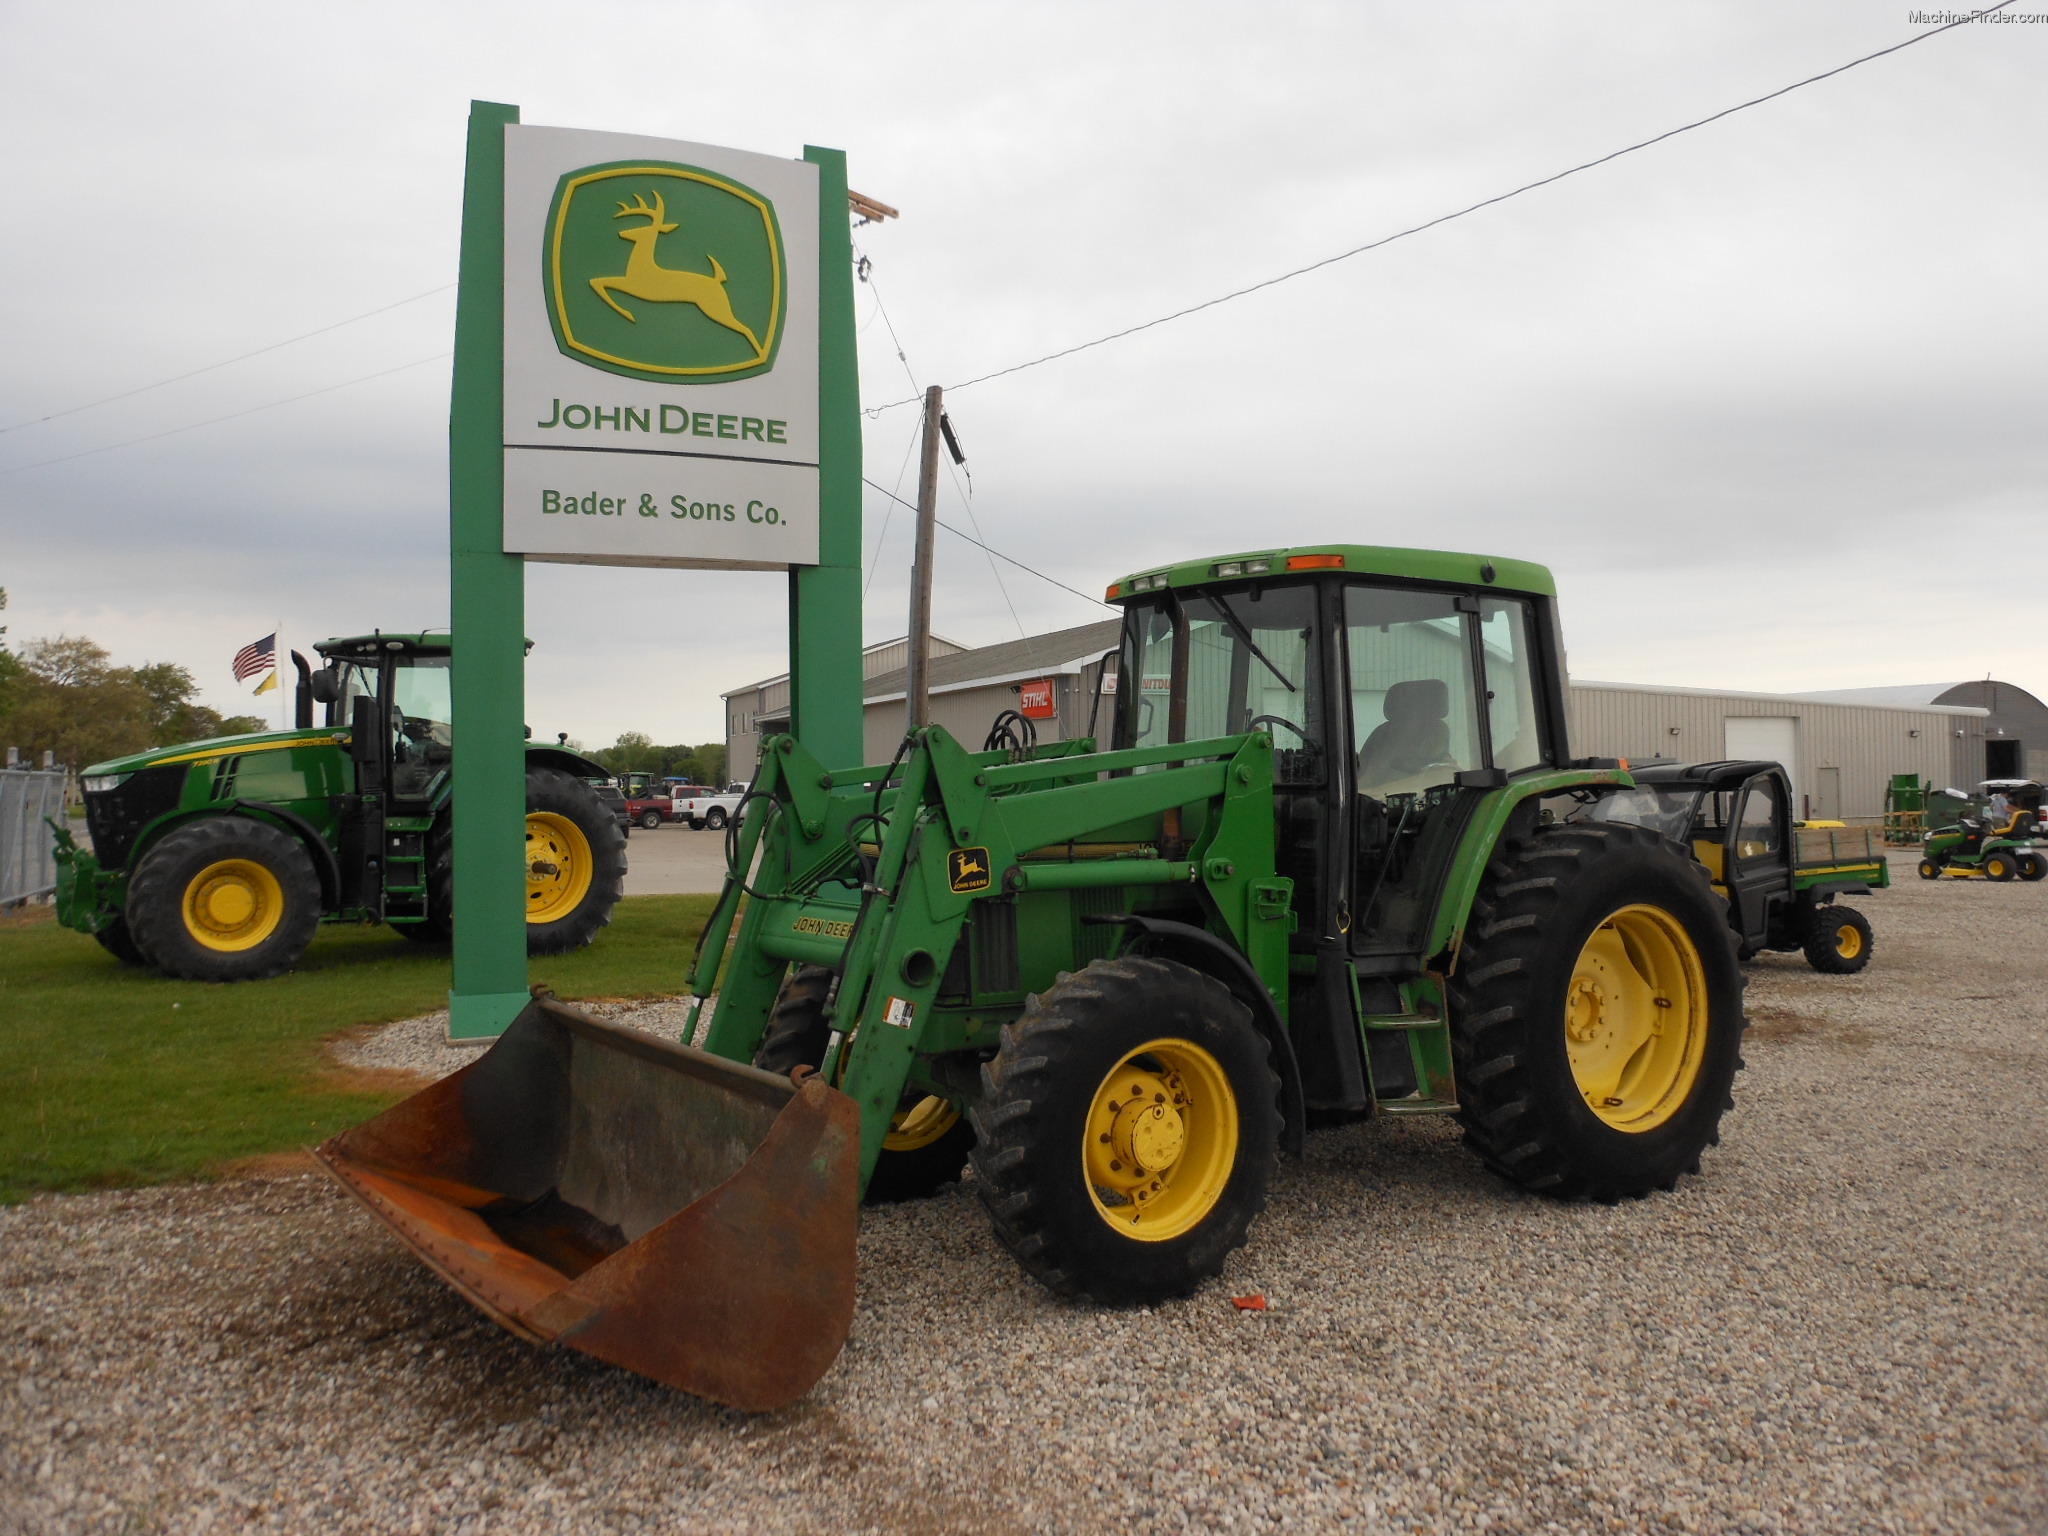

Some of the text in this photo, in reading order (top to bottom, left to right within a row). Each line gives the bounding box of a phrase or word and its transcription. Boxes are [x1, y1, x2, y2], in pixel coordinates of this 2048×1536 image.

[537, 398, 788, 444] JOHN DEERE
[541, 489, 787, 526] Bader & Sons Co.
[1022, 691, 1048, 709] STIHL
[953, 879, 988, 890] JOHN DEERE
[792, 917, 856, 938] JOHN DEER
